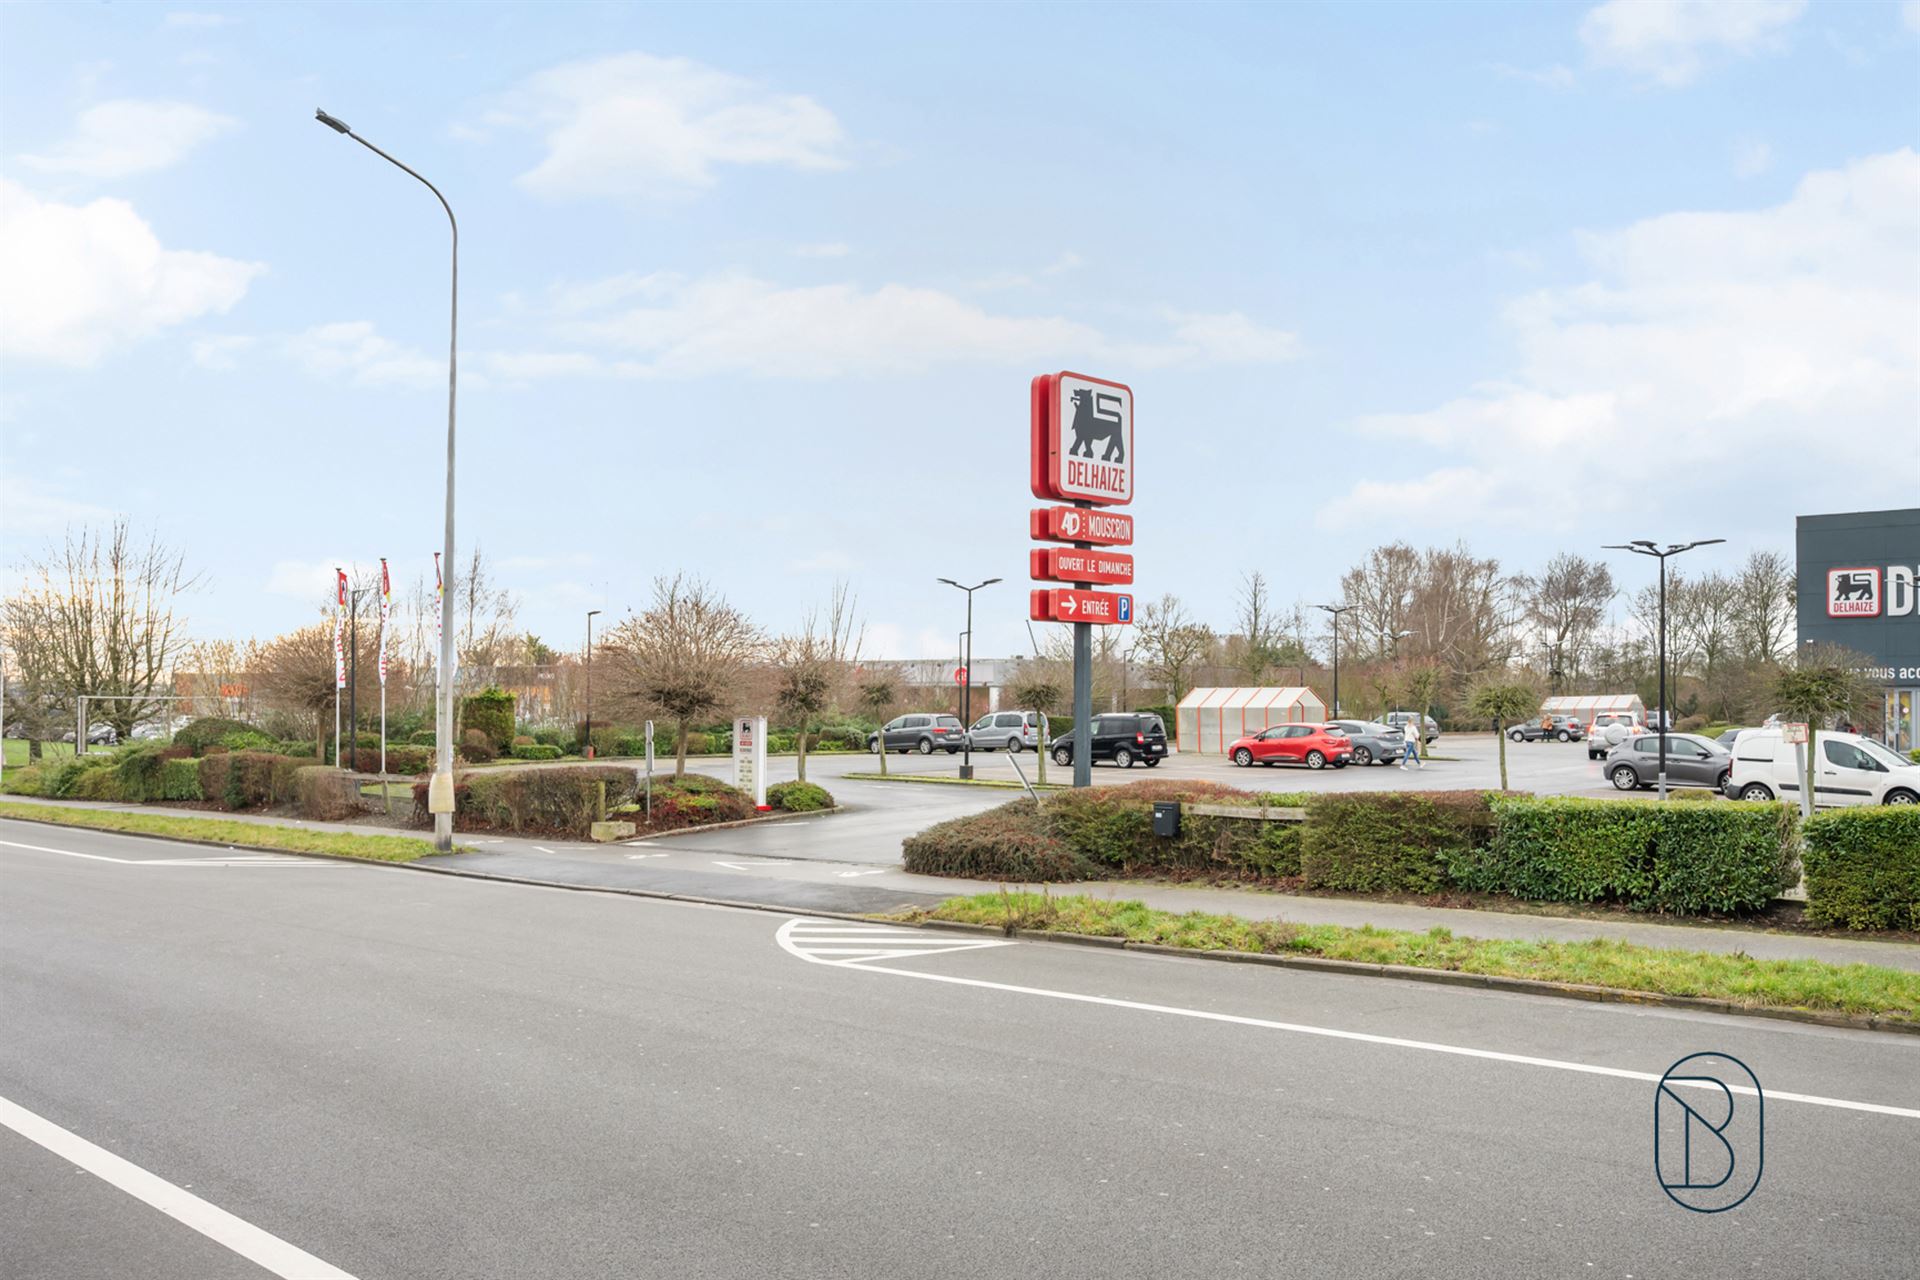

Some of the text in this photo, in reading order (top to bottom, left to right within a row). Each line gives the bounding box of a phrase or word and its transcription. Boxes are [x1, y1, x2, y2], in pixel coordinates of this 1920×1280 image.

[1068, 460, 1125, 493] DELHAIZE
[1088, 515, 1131, 541] MOUSCRON
[1058, 556, 1132, 576] OUVERT LE DIMANCHE
[1887, 565, 1920, 616] D
[1082, 597, 1109, 617] ENTRÉE
[1833, 601, 1874, 613] DELHAIZE
